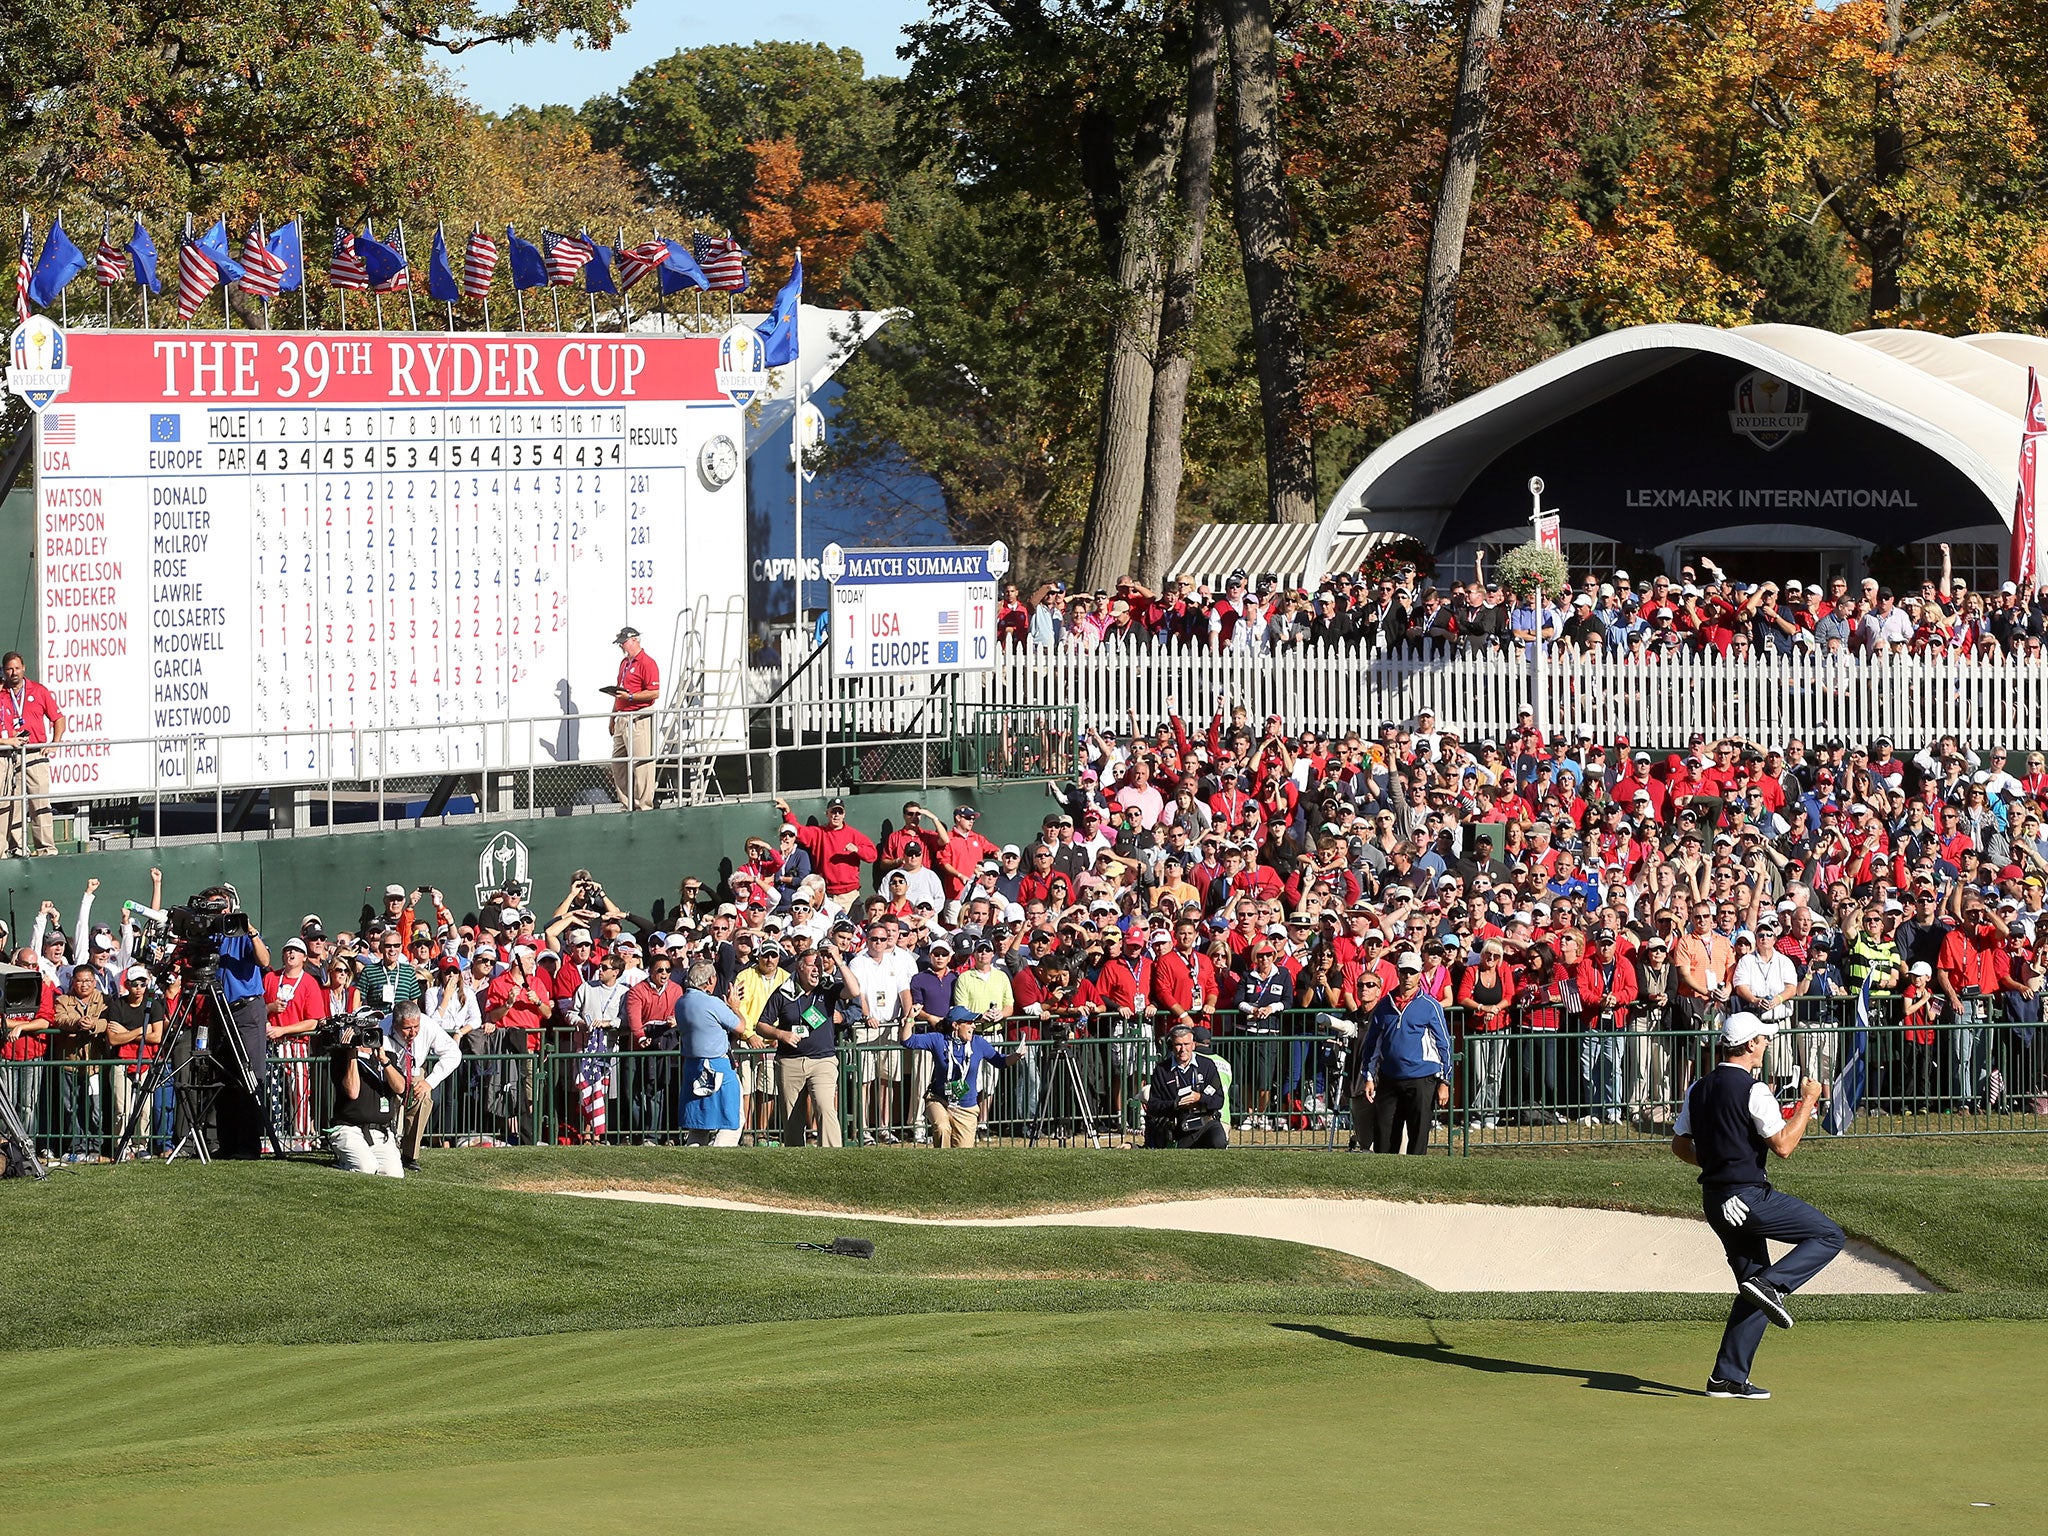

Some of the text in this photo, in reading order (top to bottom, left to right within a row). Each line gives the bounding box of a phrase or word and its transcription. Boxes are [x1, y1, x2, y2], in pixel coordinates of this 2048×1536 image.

[154, 341, 646, 398] THE 39TH RYDER CUP
[13, 374, 66, 386] RYDER CUP
[33, 392, 47, 401] 2012
[736, 392, 749, 400] 2012
[210, 414, 621, 438] HOLE 1 2 3 4 5 6 7 8 9 10 11 12 13 14 15 16 17 18
[1736, 416, 1804, 428] RYDER CUP
[630, 428, 677, 446] RESULTS
[1761, 433, 1778, 441] 2012
[44, 451, 70, 471] USA
[150, 450, 203, 470] EUROPE
[219, 444, 620, 470] PAR 4 3 4 4 5 4 5 3 4 5 4 4 3 5 4 4 3 4
[325, 482, 332, 501] 2
[344, 481, 350, 500] 2
[367, 481, 373, 500] 2
[387, 480, 394, 499] 2
[408, 480, 414, 499] 2
[430, 480, 437, 498] 2
[454, 480, 460, 499] 2
[472, 478, 478, 497] 3
[492, 478, 499, 496] 4
[514, 477, 520, 494] 4
[534, 476, 540, 494] 4
[555, 476, 561, 494] 3
[577, 475, 583, 493] 2
[595, 475, 600, 493] 2
[630, 475, 649, 494] 2&1
[46, 488, 101, 507] WATSON
[154, 487, 206, 506] DONALD
[1626, 489, 1918, 507] LEXMARK INTERNATIONAL
[154, 511, 210, 530] POULTER
[326, 506, 373, 526] 2 2
[631, 502, 637, 520] 2
[46, 513, 104, 532] SIMPSON
[154, 534, 208, 553] McILROY
[367, 522, 559, 548] 2 2 2 2
[631, 526, 650, 545] 2&1
[47, 537, 107, 556] BRADLEY
[47, 562, 121, 582] MICKELSON
[154, 559, 186, 577] ROSE
[280, 553, 311, 573] 2 2
[631, 560, 653, 579] 5&3
[753, 558, 820, 581] CAPTANS
[849, 556, 982, 577] MATCH SUMMARY
[346, 568, 541, 594] 2 2 2 2 3 2 3 4 5 4
[47, 587, 115, 607] SNEDEKER
[154, 583, 202, 602] LAWRIE
[631, 586, 653, 605] 3&2
[837, 590, 863, 603] TODAY
[968, 587, 992, 600] TOTAL
[474, 595, 479, 614] 2
[48, 612, 126, 633] D. JOHNSON
[154, 608, 225, 628] COLSAERTS
[849, 606, 983, 638] 1 USA 11
[305, 619, 479, 644] 2 3 2 2 3 3 2 2 2
[48, 638, 126, 658] Z. JOHNSON
[154, 633, 223, 653] McDOWELL
[845, 636, 986, 669] 4 EUROPE 10
[48, 664, 91, 683] FURYK
[154, 658, 202, 678] GARCIA
[390, 666, 482, 689] 3 4 4 3 2
[155, 682, 207, 702] HANSON
[155, 706, 230, 727] WESTWOOD
[49, 763, 98, 783] WOODS
[158, 755, 216, 777] OLIARI
